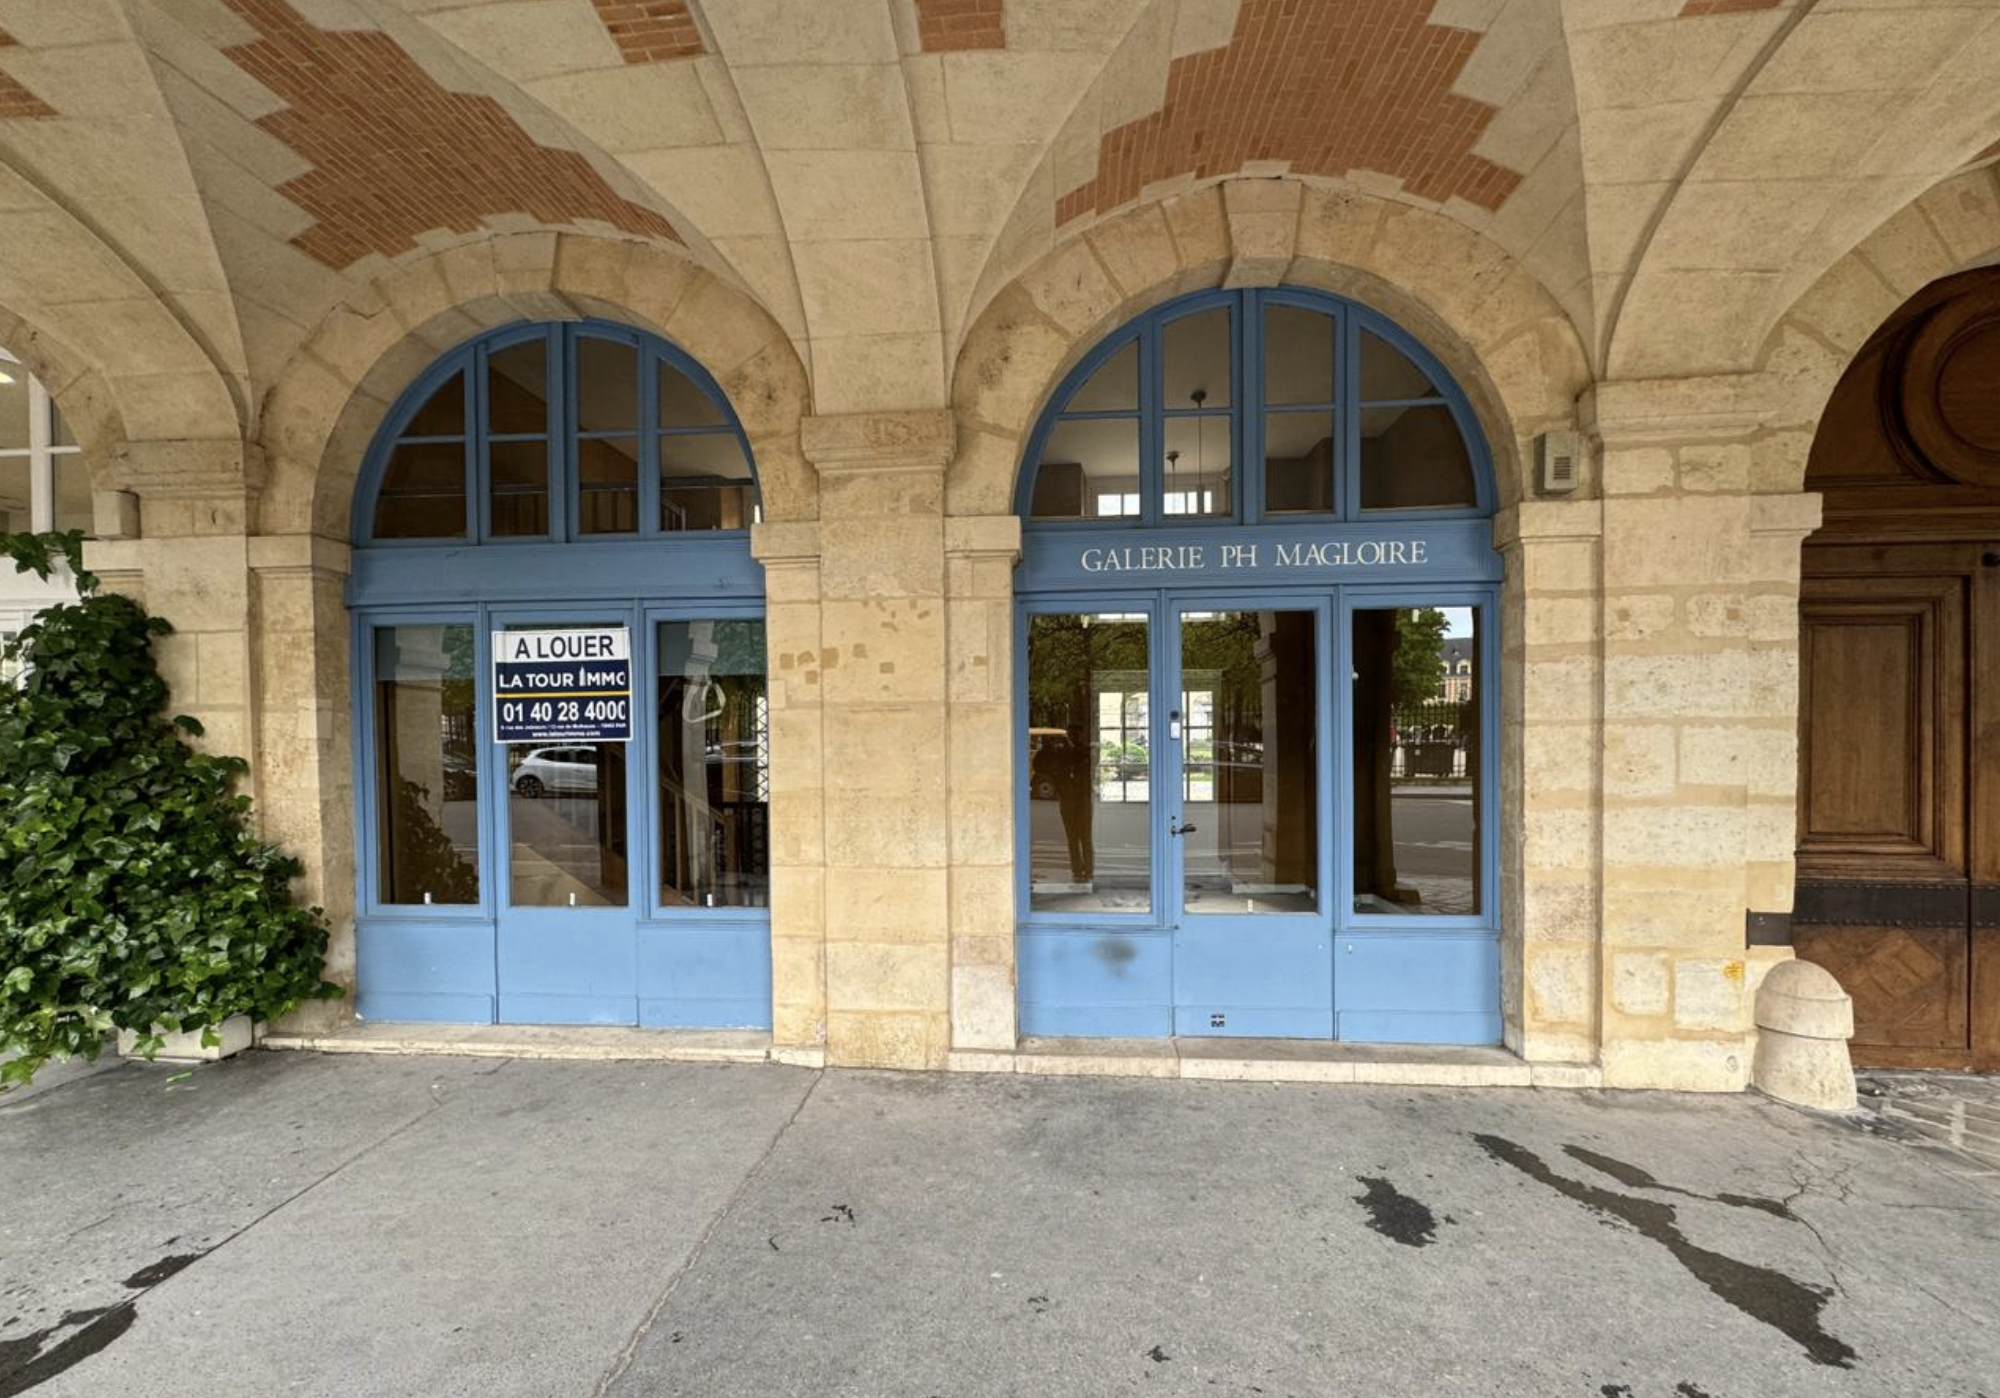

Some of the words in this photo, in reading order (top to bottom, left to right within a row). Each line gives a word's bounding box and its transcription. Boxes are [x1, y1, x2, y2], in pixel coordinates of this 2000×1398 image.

[1081, 546, 1205, 572] GALERIE
[1219, 545, 1258, 568] PH
[1275, 541, 1429, 566] MAGLOIRE
[515, 637, 531, 659] A
[537, 635, 614, 658] LOUER
[499, 673, 523, 688] LA
[525, 672, 574, 688] TOUR
[503, 702, 523, 722] 01
[530, 701, 552, 721] 40
[557, 701, 579, 721] 28
